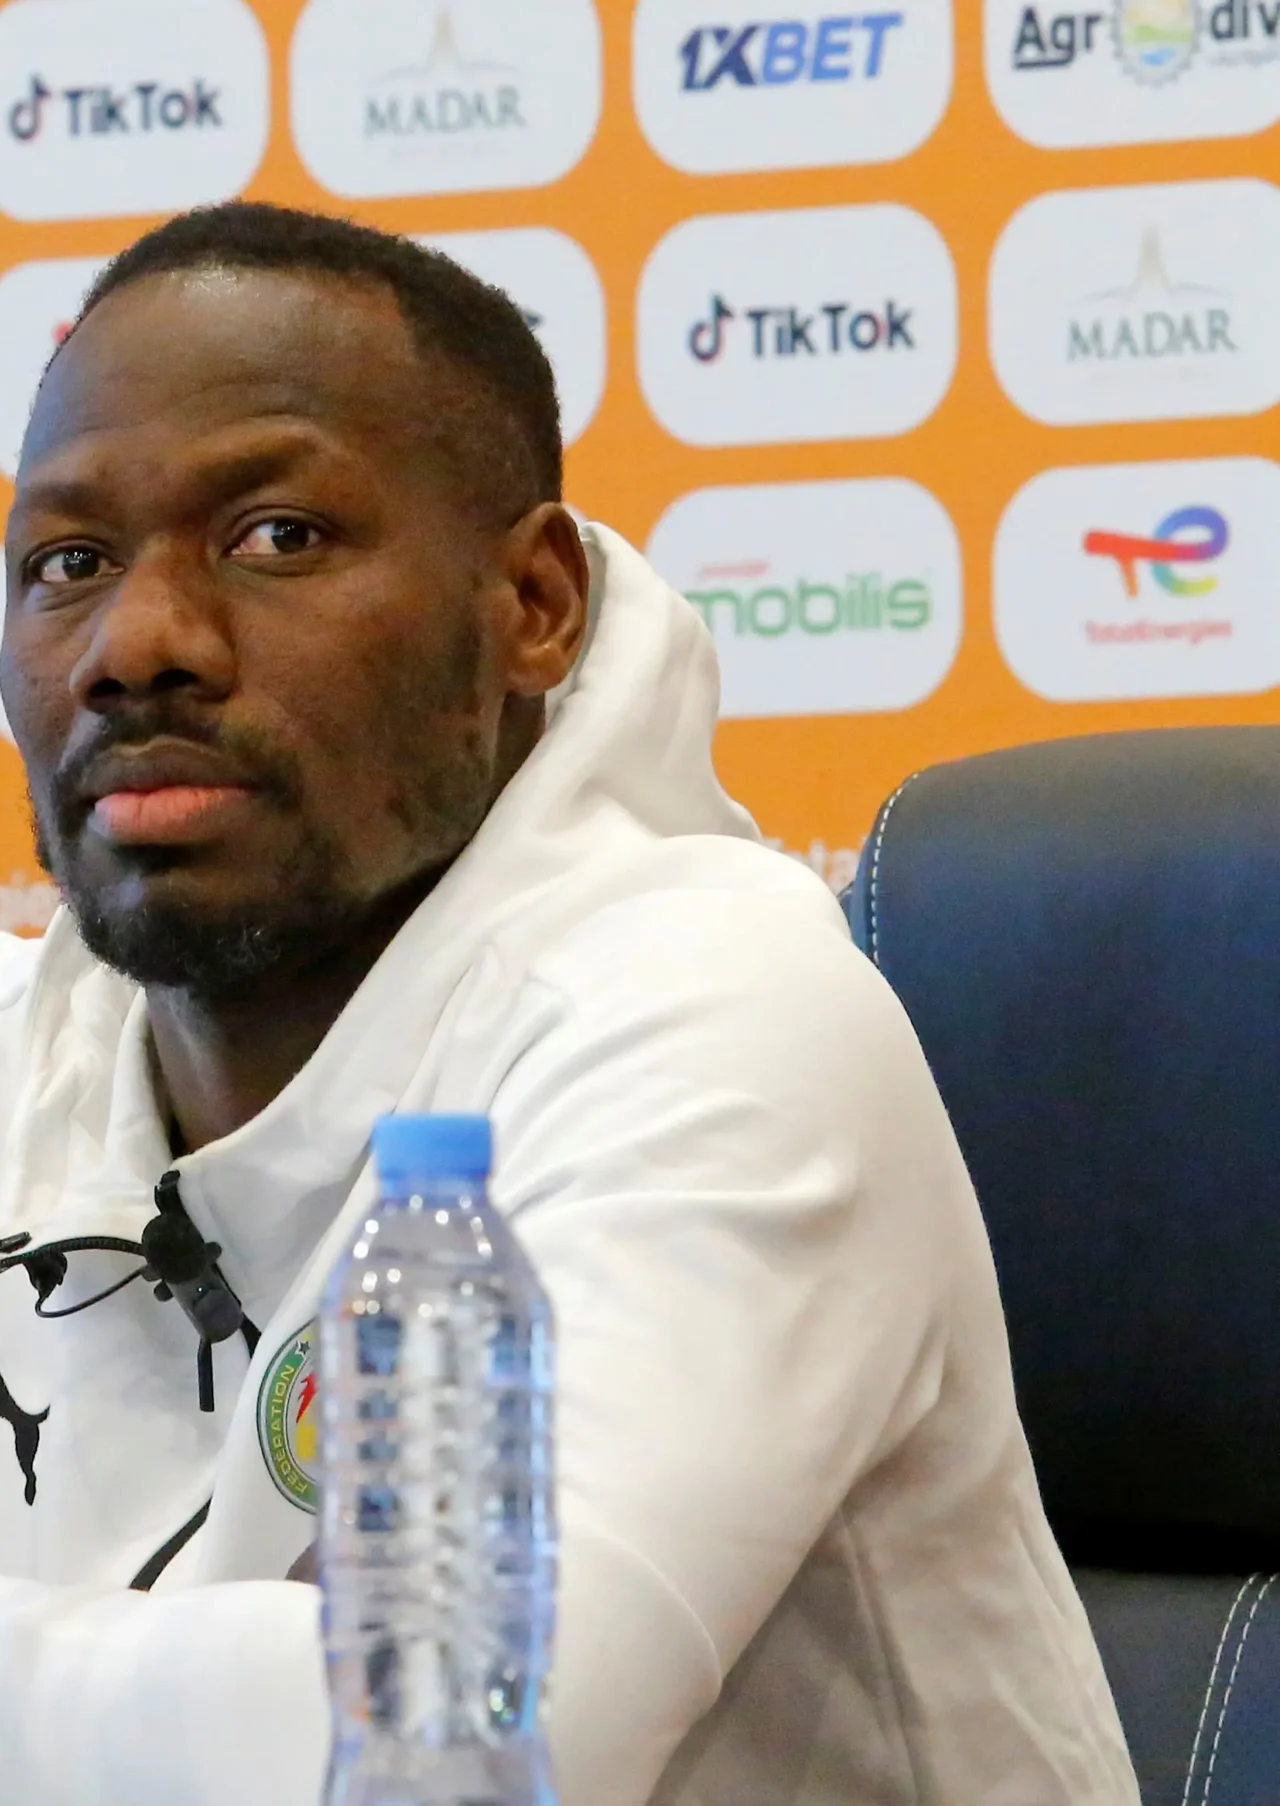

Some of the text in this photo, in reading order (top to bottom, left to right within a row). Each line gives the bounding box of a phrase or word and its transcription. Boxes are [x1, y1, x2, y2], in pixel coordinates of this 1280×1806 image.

[678, 13, 903, 92] 1XBET
[62, 79, 222, 137] TikTok
[363, 85, 528, 139] MADAR
[745, 300, 915, 359] TikTok
[1066, 308, 1238, 363] MADAR
